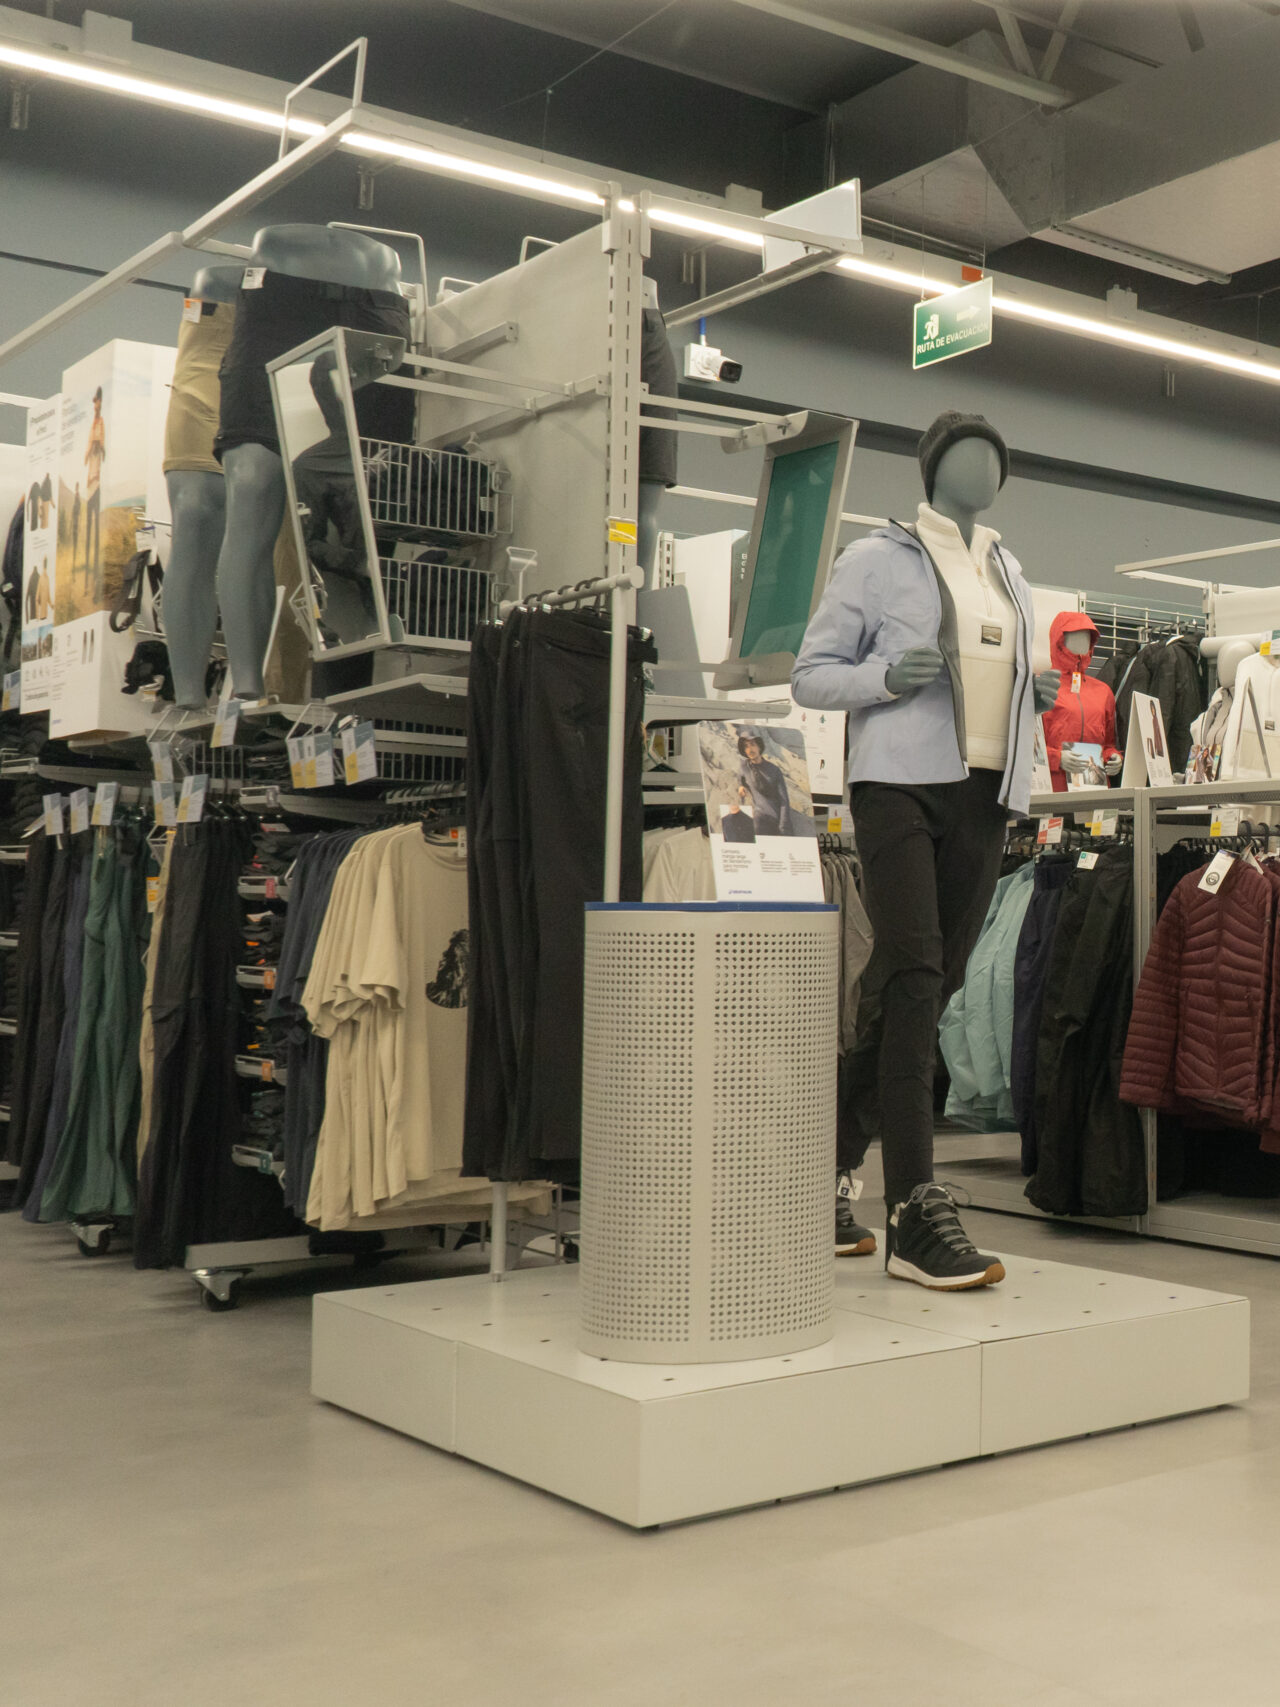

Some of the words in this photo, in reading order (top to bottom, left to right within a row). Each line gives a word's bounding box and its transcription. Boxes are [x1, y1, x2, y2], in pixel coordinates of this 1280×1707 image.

[917, 342, 935, 354] RUTA
[935, 337, 945, 347] DE
[946, 322, 988, 344] EVACUACN
